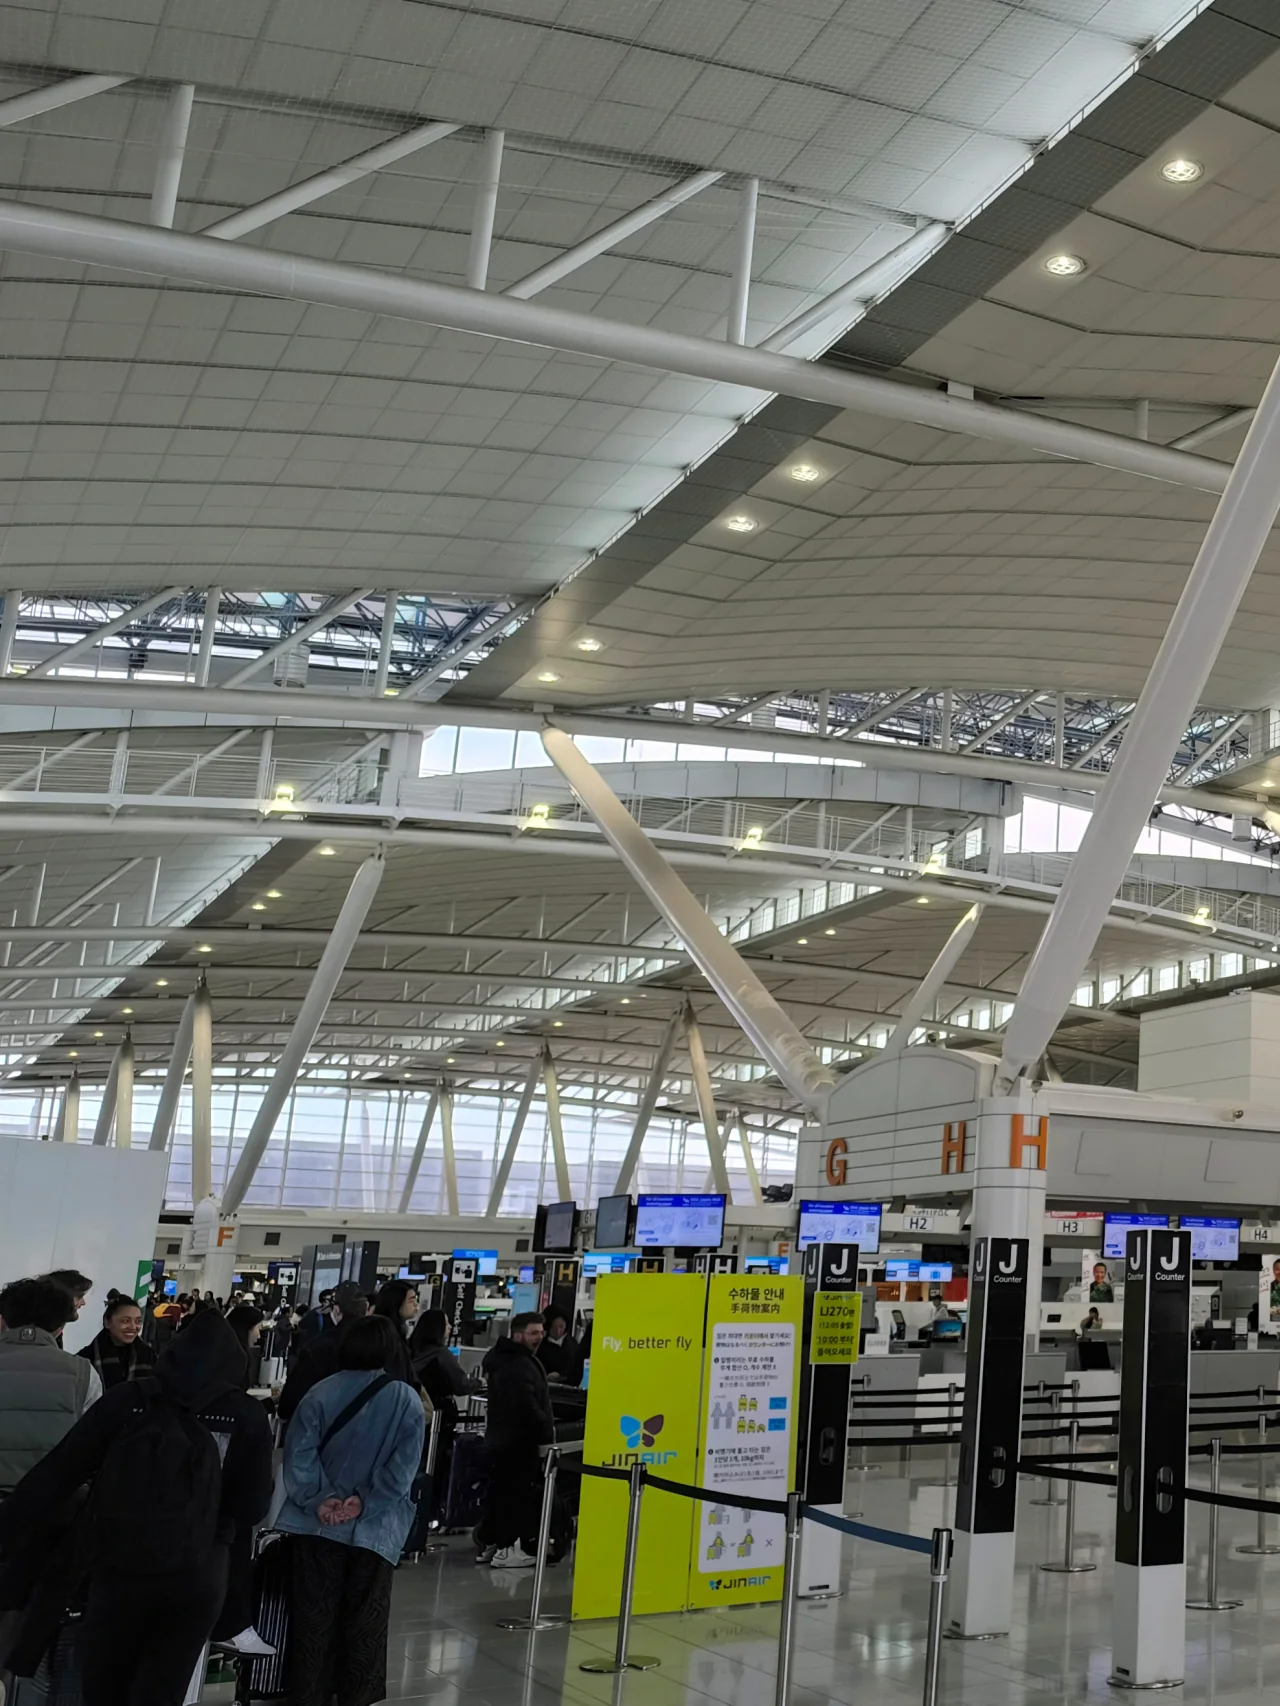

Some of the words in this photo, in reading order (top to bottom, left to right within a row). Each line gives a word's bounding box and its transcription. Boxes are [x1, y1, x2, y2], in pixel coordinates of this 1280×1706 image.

[941, 1120, 967, 1175] H
[1009, 1113, 1048, 1170] H
[825, 1138, 848, 1186] G
[910, 1217, 927, 1230] H2
[1063, 1221, 1078, 1233] H3
[217, 1226, 235, 1247] F
[1255, 1229, 1268, 1240] H4
[809, 1248, 816, 1275] J
[830, 1248, 849, 1275] J
[975, 1243, 985, 1273] J
[999, 1244, 1018, 1274] J
[1130, 1237, 1141, 1271] J
[1160, 1237, 1180, 1271] J
[559, 1263, 574, 1281] H
[642, 1261, 659, 1273] H
[715, 1258, 732, 1274] H
[430, 1276, 440, 1286] G
[825, 1276, 852, 1284] Counter
[993, 1275, 1022, 1284] Counter
[1127, 1273, 1144, 1281] Counter
[1155, 1273, 1185, 1281] Counter
[457, 1284, 466, 1299] Self
[728, 1288, 760, 1300] 수하물
[764, 1288, 785, 1300] 안내
[731, 1303, 780, 1314] 手荷物案内
[453, 1301, 463, 1335] Check-in
[629, 1337, 671, 1349] better
[676, 1336, 692, 1351] fly
[724, 1575, 771, 1589] JINAIR
